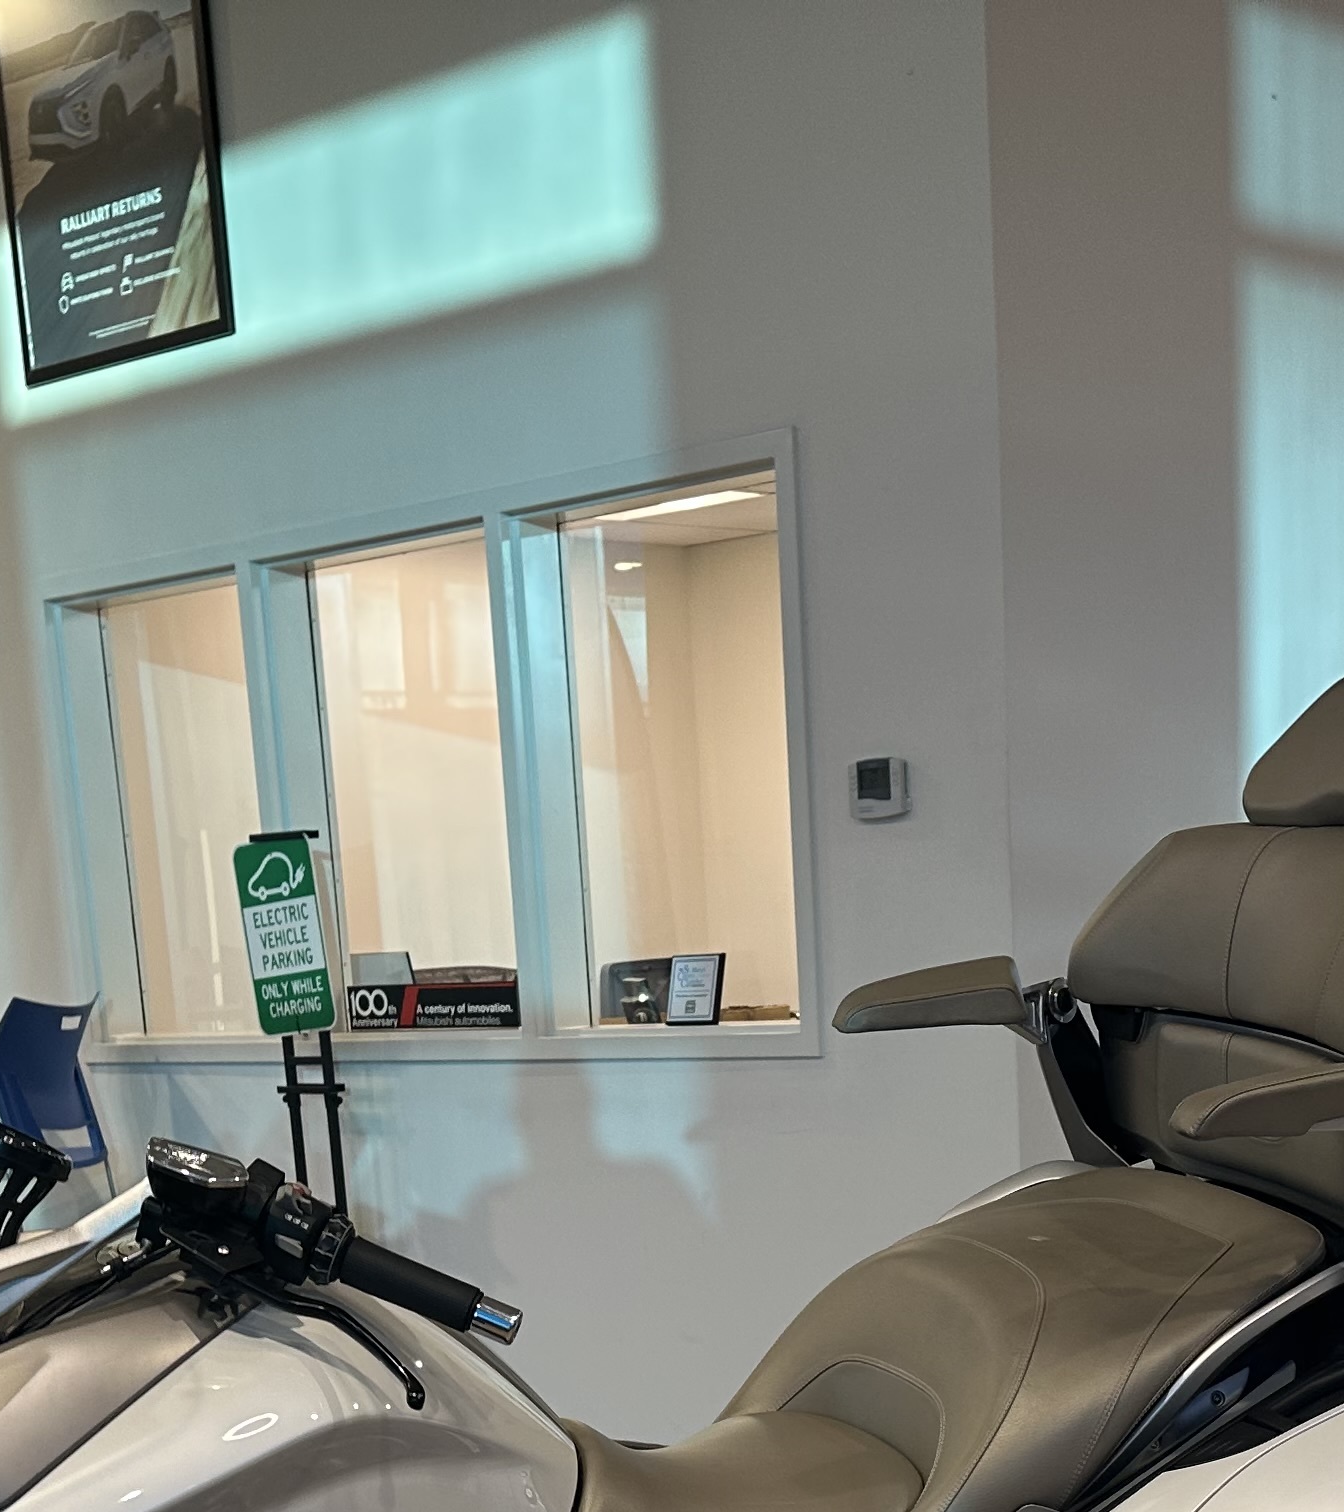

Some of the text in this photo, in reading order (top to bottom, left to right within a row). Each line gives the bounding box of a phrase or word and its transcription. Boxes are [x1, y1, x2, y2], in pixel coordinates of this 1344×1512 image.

[60, 204, 111, 235] RALLIART
[111, 187, 163, 217] RETURNS
[252, 902, 309, 929] ELECTRIC
[259, 925, 309, 950] VEHICLE
[262, 947, 314, 972] PARKING
[261, 975, 324, 1000] ONLY WHILE
[269, 996, 322, 1018] CHARGING
[416, 1004, 423, 1014] A
[424, 1003, 455, 1016] century
[457, 1003, 466, 1013] of
[352, 1018, 399, 1028] Anniversary
[416, 1016, 453, 1026] Mitsubishi
